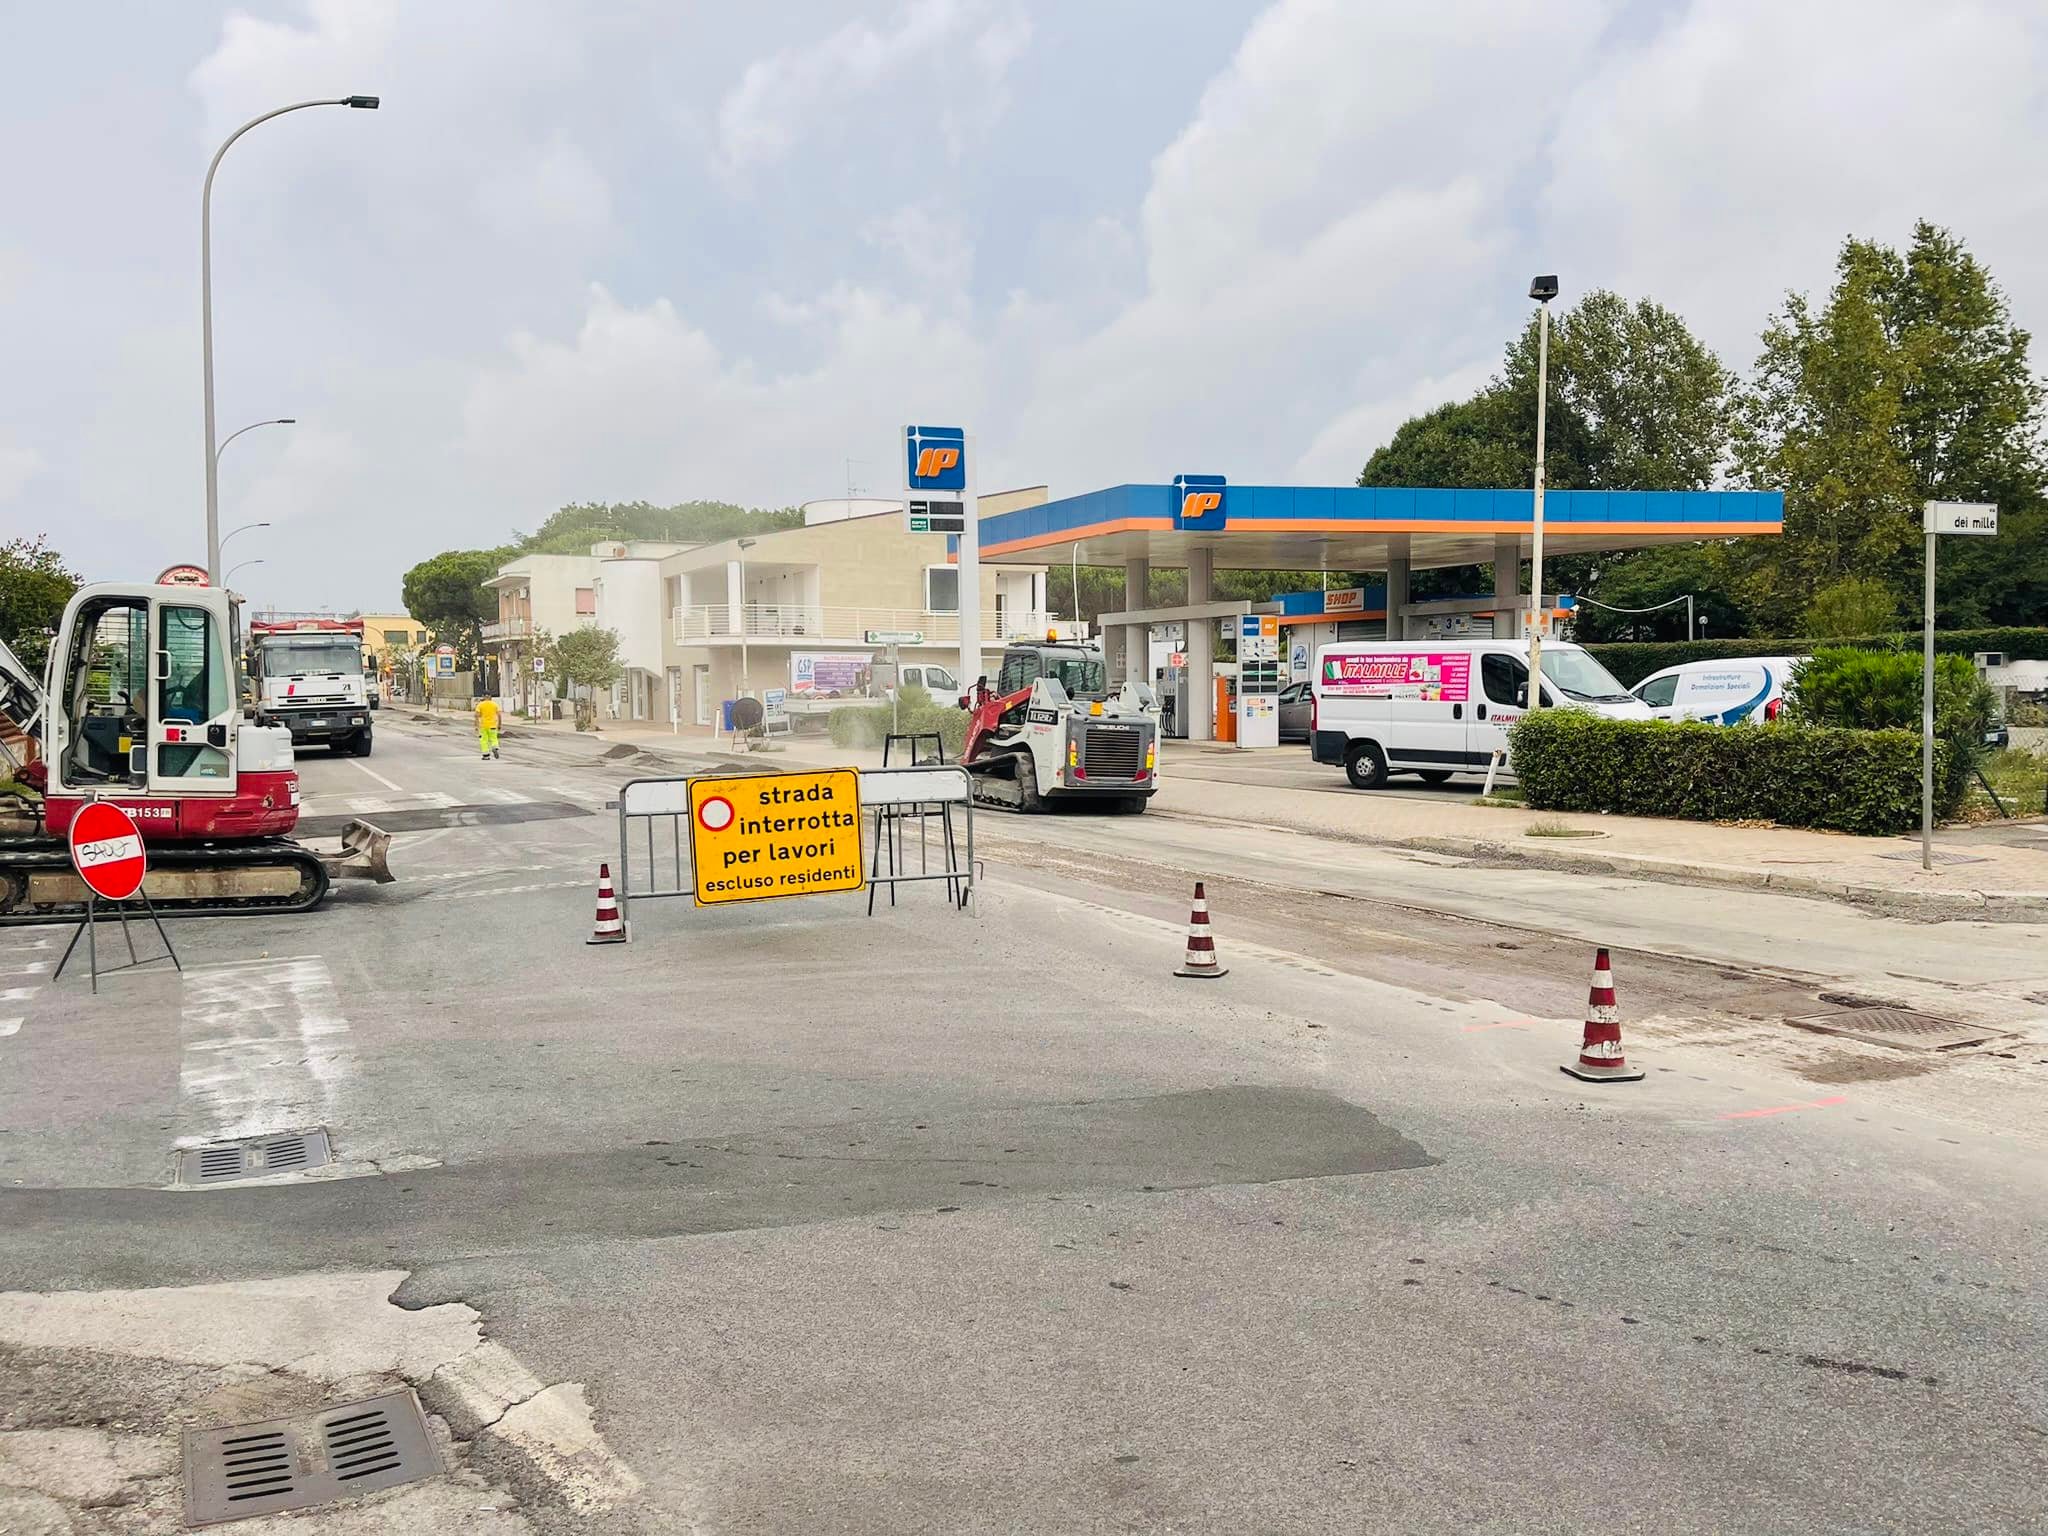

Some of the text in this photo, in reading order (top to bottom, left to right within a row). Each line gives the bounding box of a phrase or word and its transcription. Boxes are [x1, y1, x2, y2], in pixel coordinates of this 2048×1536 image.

[915, 447, 960, 477] IP
[1180, 492, 1222, 518] IP
[1955, 516, 1995, 528] dei mille
[1326, 592, 1357, 605] SHOP
[1446, 618, 1452, 630] 3
[1342, 663, 1409, 679] ITALMILLE
[759, 783, 834, 805] strada
[739, 810, 854, 835] interrotta
[723, 838, 835, 869] per lavori
[705, 864, 855, 892] escluso residenti
